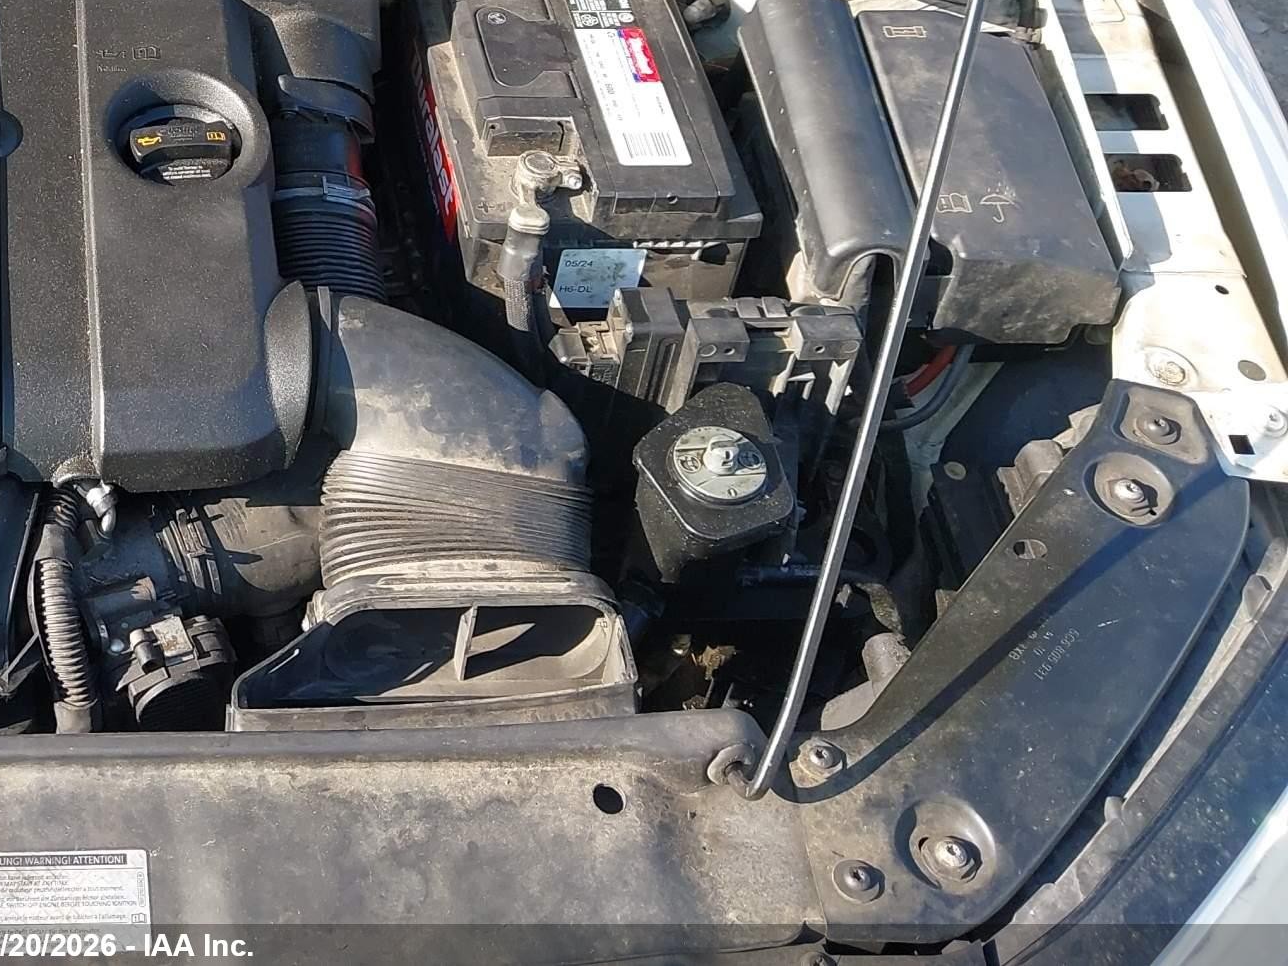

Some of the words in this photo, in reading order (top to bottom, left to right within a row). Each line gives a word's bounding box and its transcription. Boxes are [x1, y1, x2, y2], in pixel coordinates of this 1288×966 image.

[564, 260, 593, 268] 05/24
[24, 855, 71, 866] WARNING!
[72, 854, 124, 865] ATTENTION!
